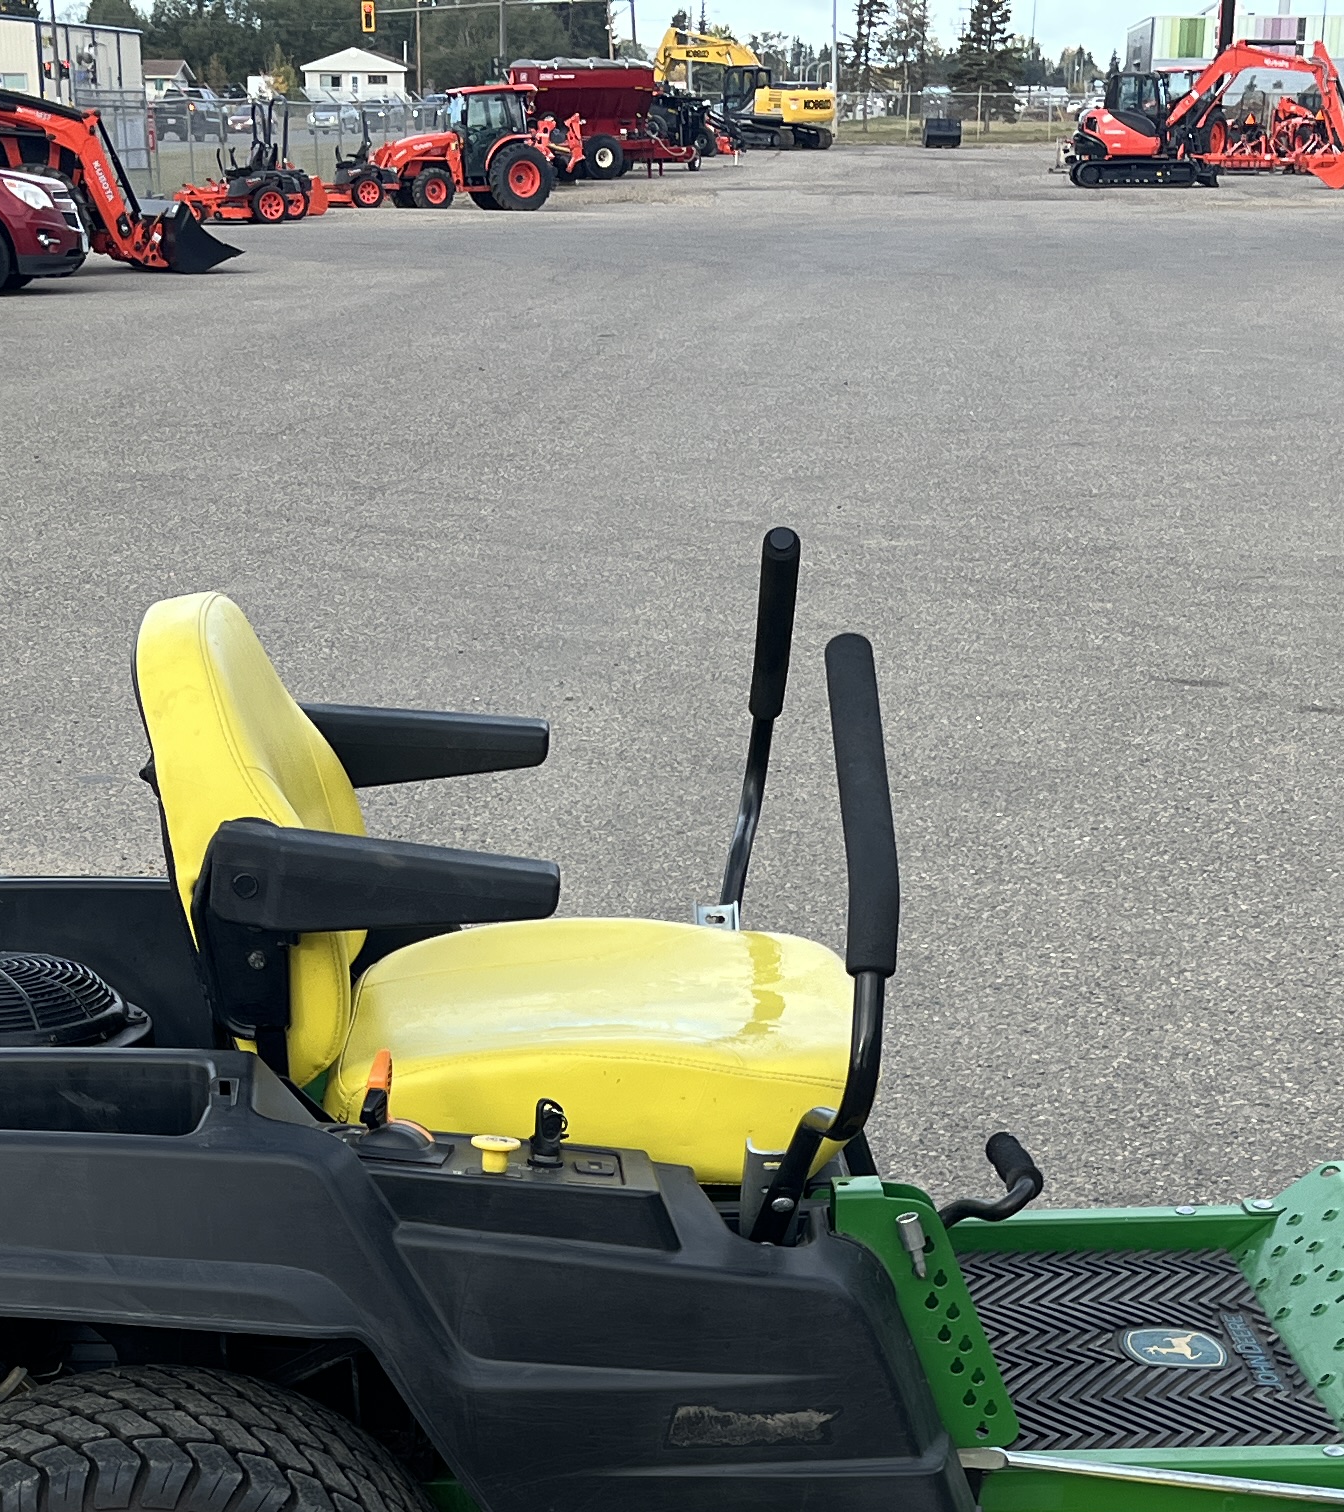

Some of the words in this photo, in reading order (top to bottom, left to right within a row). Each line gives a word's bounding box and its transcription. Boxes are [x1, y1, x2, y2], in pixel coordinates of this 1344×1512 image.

[93, 160, 114, 202] KUBOTA
[1222, 1314, 1263, 1354] DEERE
[1245, 1354, 1284, 1390] JOHN
